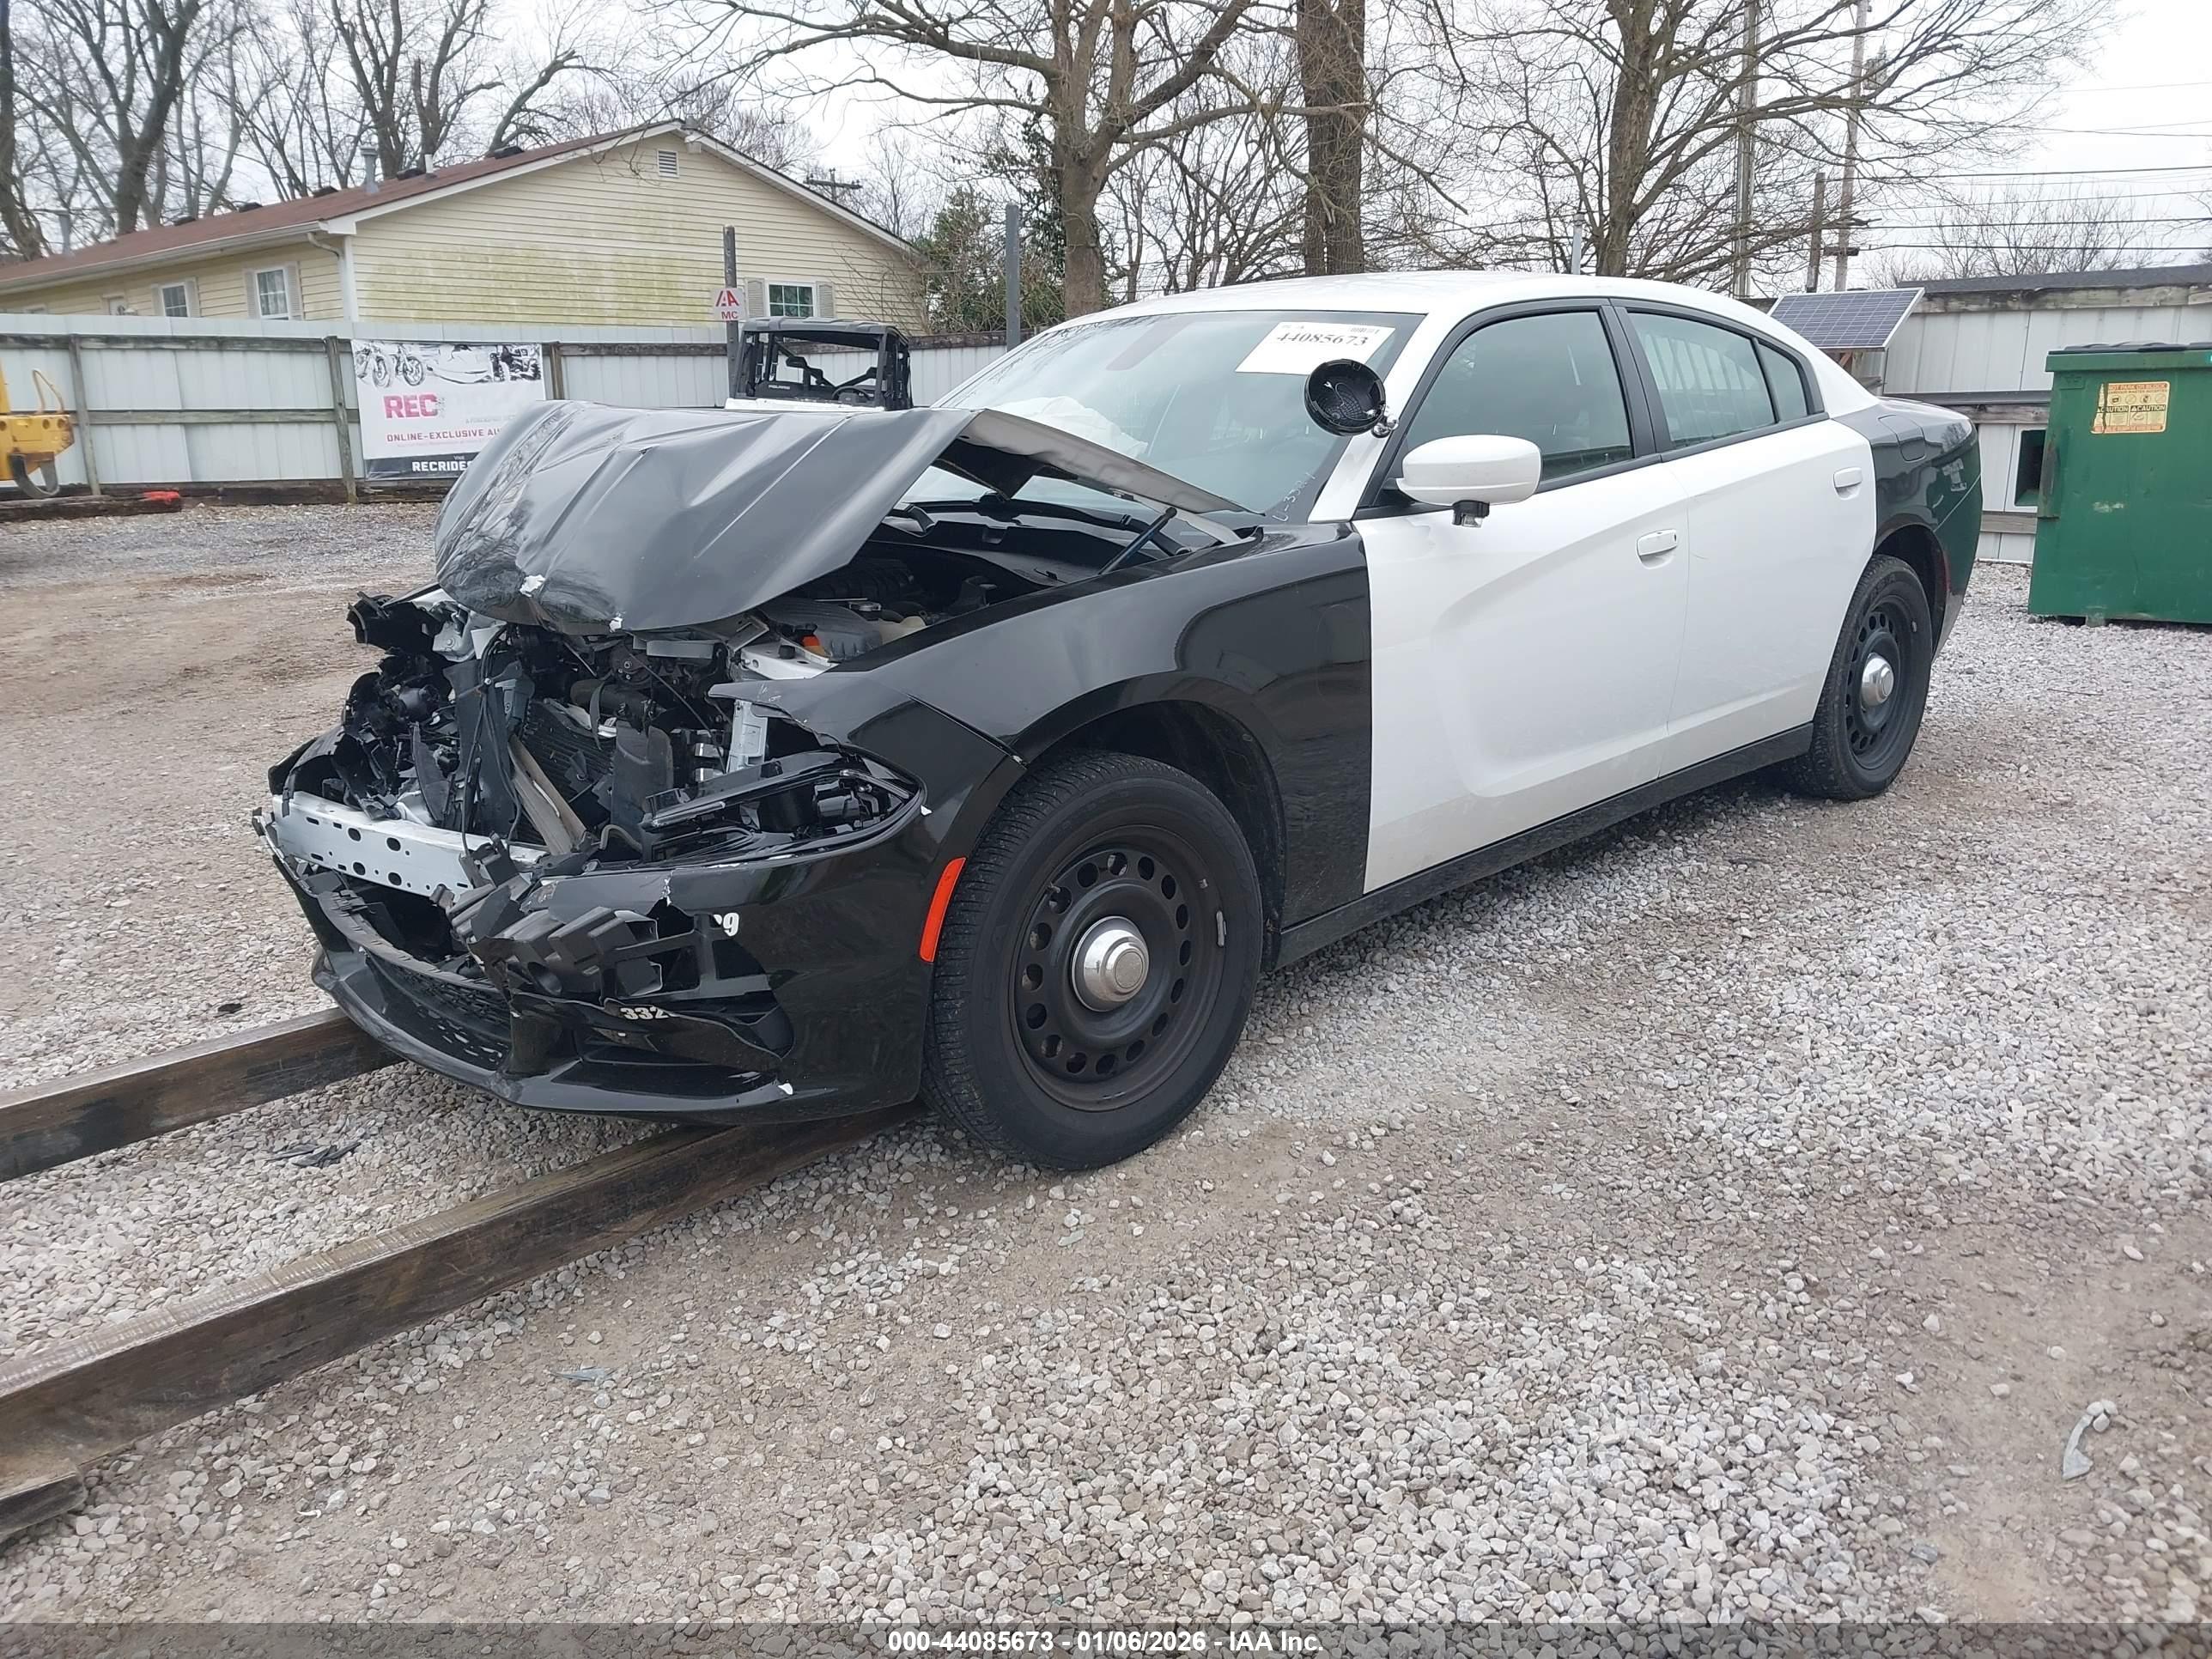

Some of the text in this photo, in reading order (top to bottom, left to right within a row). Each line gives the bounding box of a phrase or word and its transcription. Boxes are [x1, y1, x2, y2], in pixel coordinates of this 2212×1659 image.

[721, 310, 738, 320] MC
[1277, 332, 1369, 346] 44085673
[386, 428, 485, 442] ONLINE-EXCLUSIVE
[411, 460, 473, 472] RECRIDE
